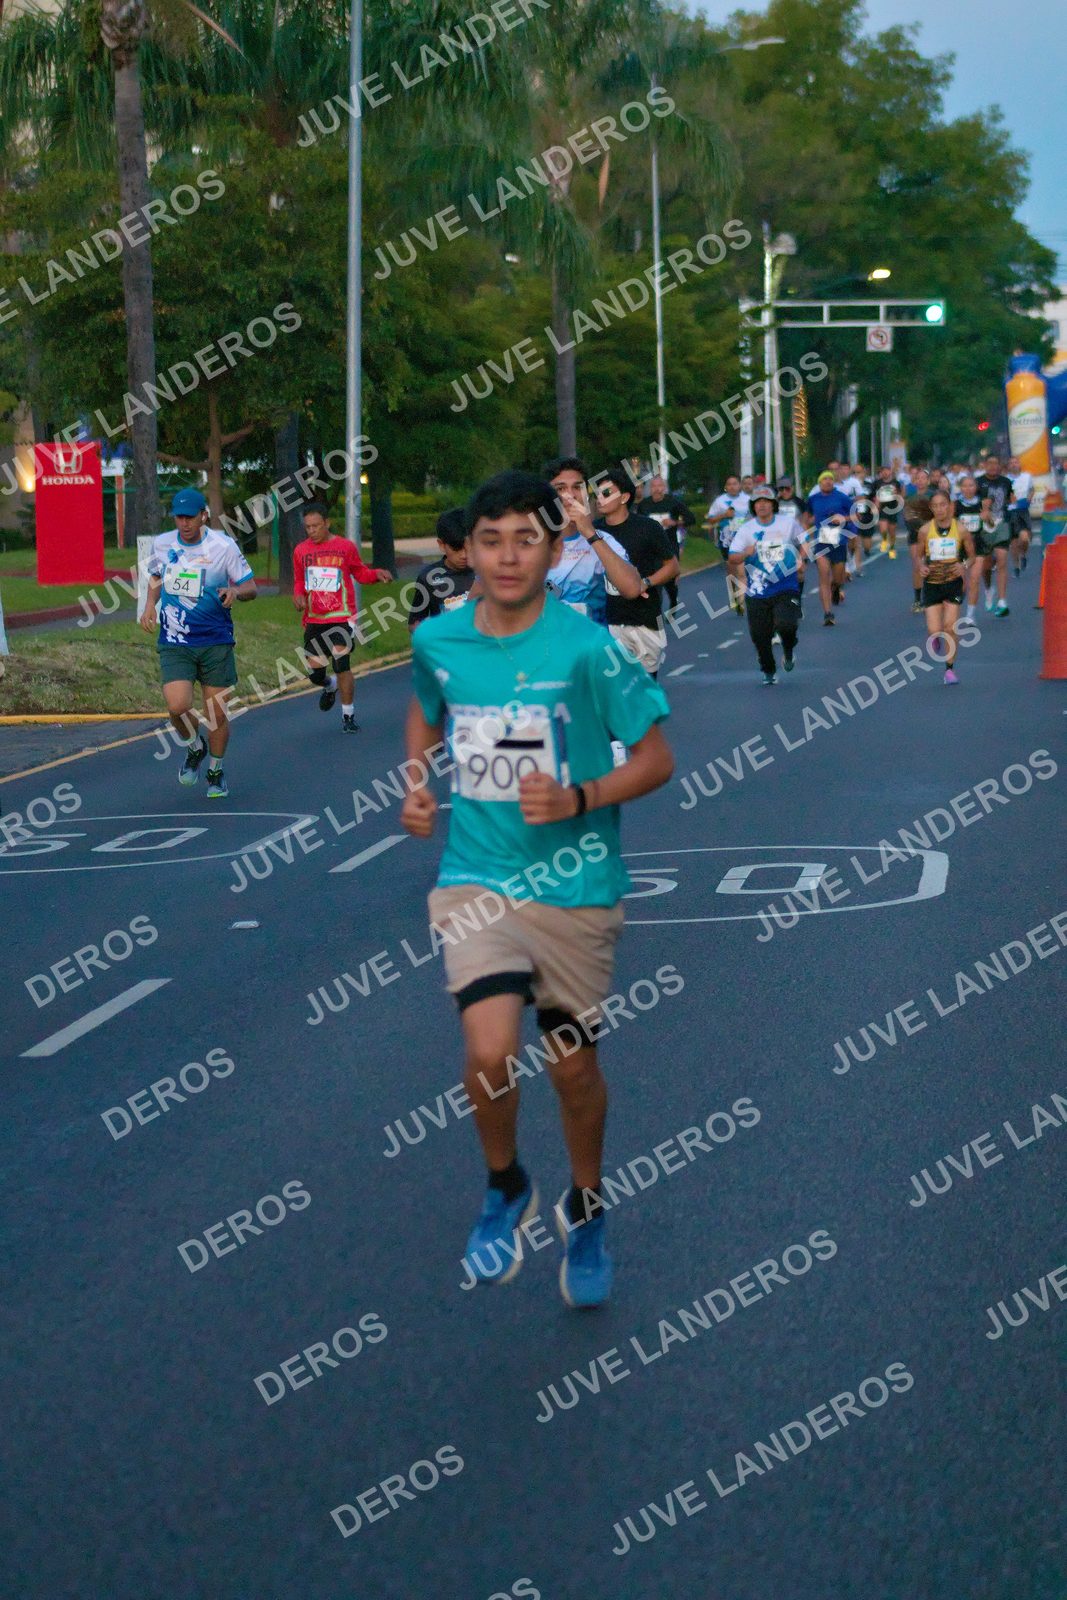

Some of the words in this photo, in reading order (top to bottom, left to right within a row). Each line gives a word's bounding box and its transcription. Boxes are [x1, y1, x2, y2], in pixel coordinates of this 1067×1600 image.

[42, 474, 95, 486] HONDA
[172, 578, 190, 592] 54
[312, 577, 333, 588] 377
[468, 754, 539, 790] 900
